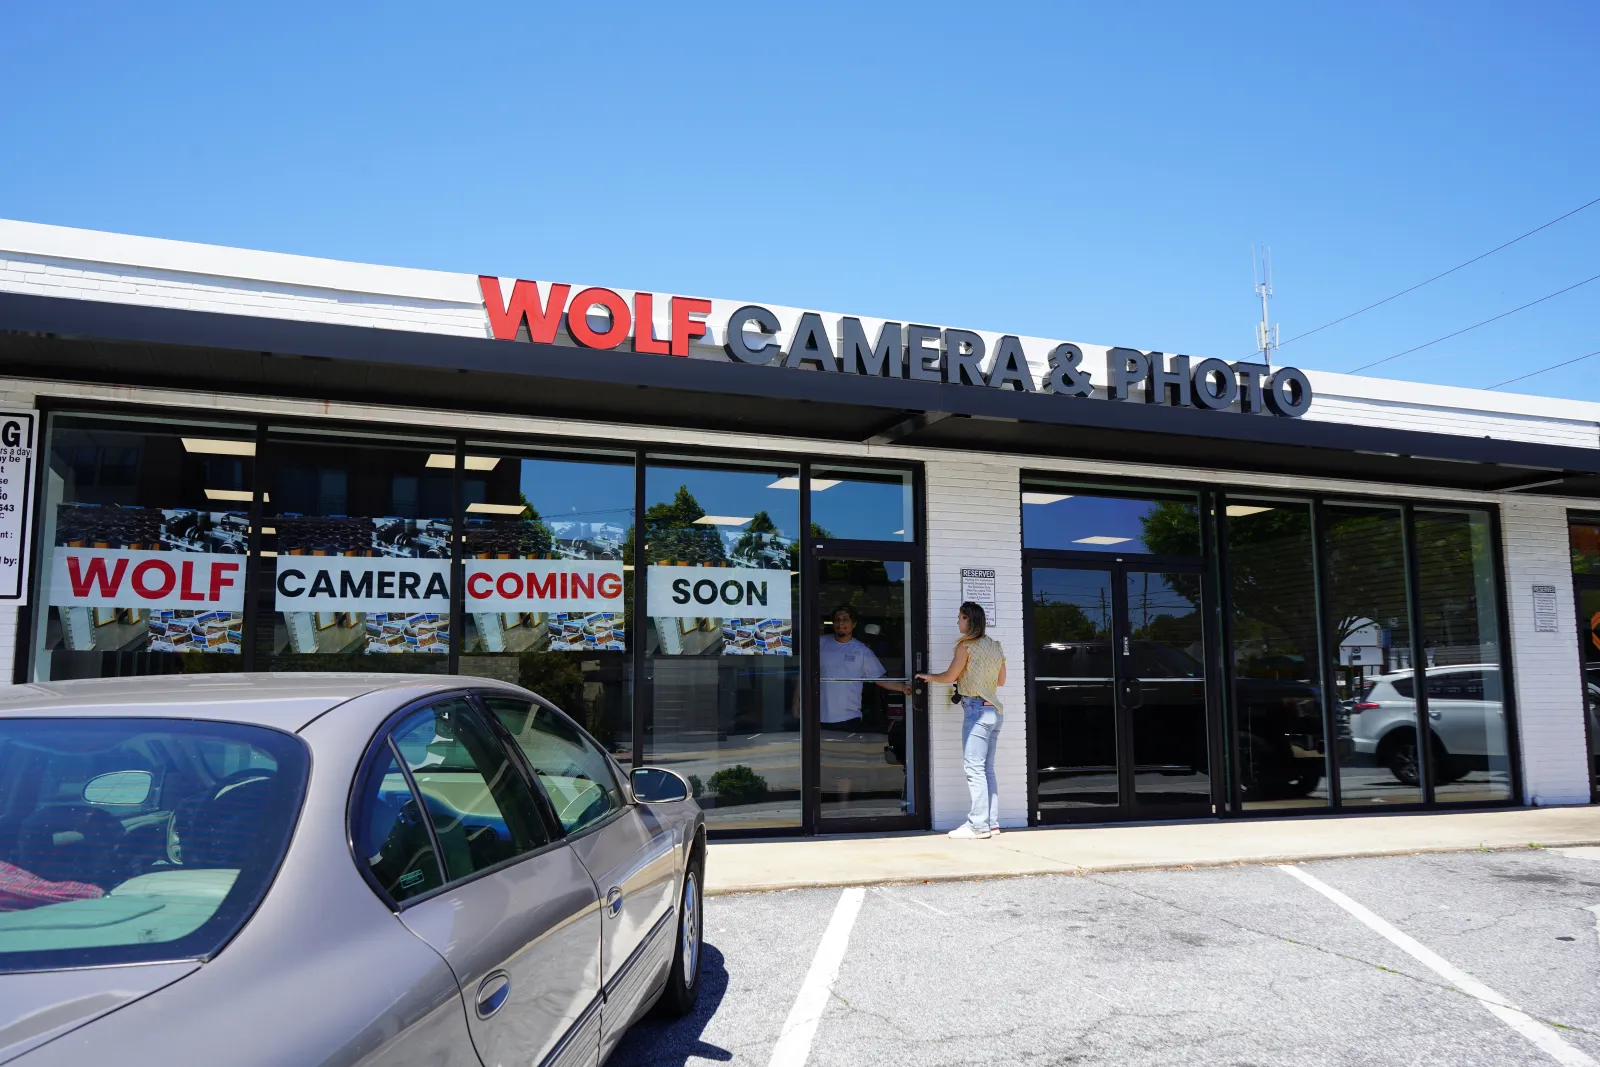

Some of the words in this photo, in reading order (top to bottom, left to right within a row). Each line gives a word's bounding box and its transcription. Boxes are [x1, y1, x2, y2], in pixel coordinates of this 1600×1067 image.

[478, 275, 712, 357] WOLF
[727, 304, 1035, 392] CAMERA
[1043, 343, 1095, 398] &
[1109, 346, 1313, 418] PHOTO
[9, 455, 21, 463] be
[17, 448, 30, 457] day
[4, 556, 17, 566] by:
[66, 556, 240, 602] WOLF
[276, 569, 450, 600] CAMERA
[466, 571, 623, 600] COMING
[671, 578, 768, 607] SOON
